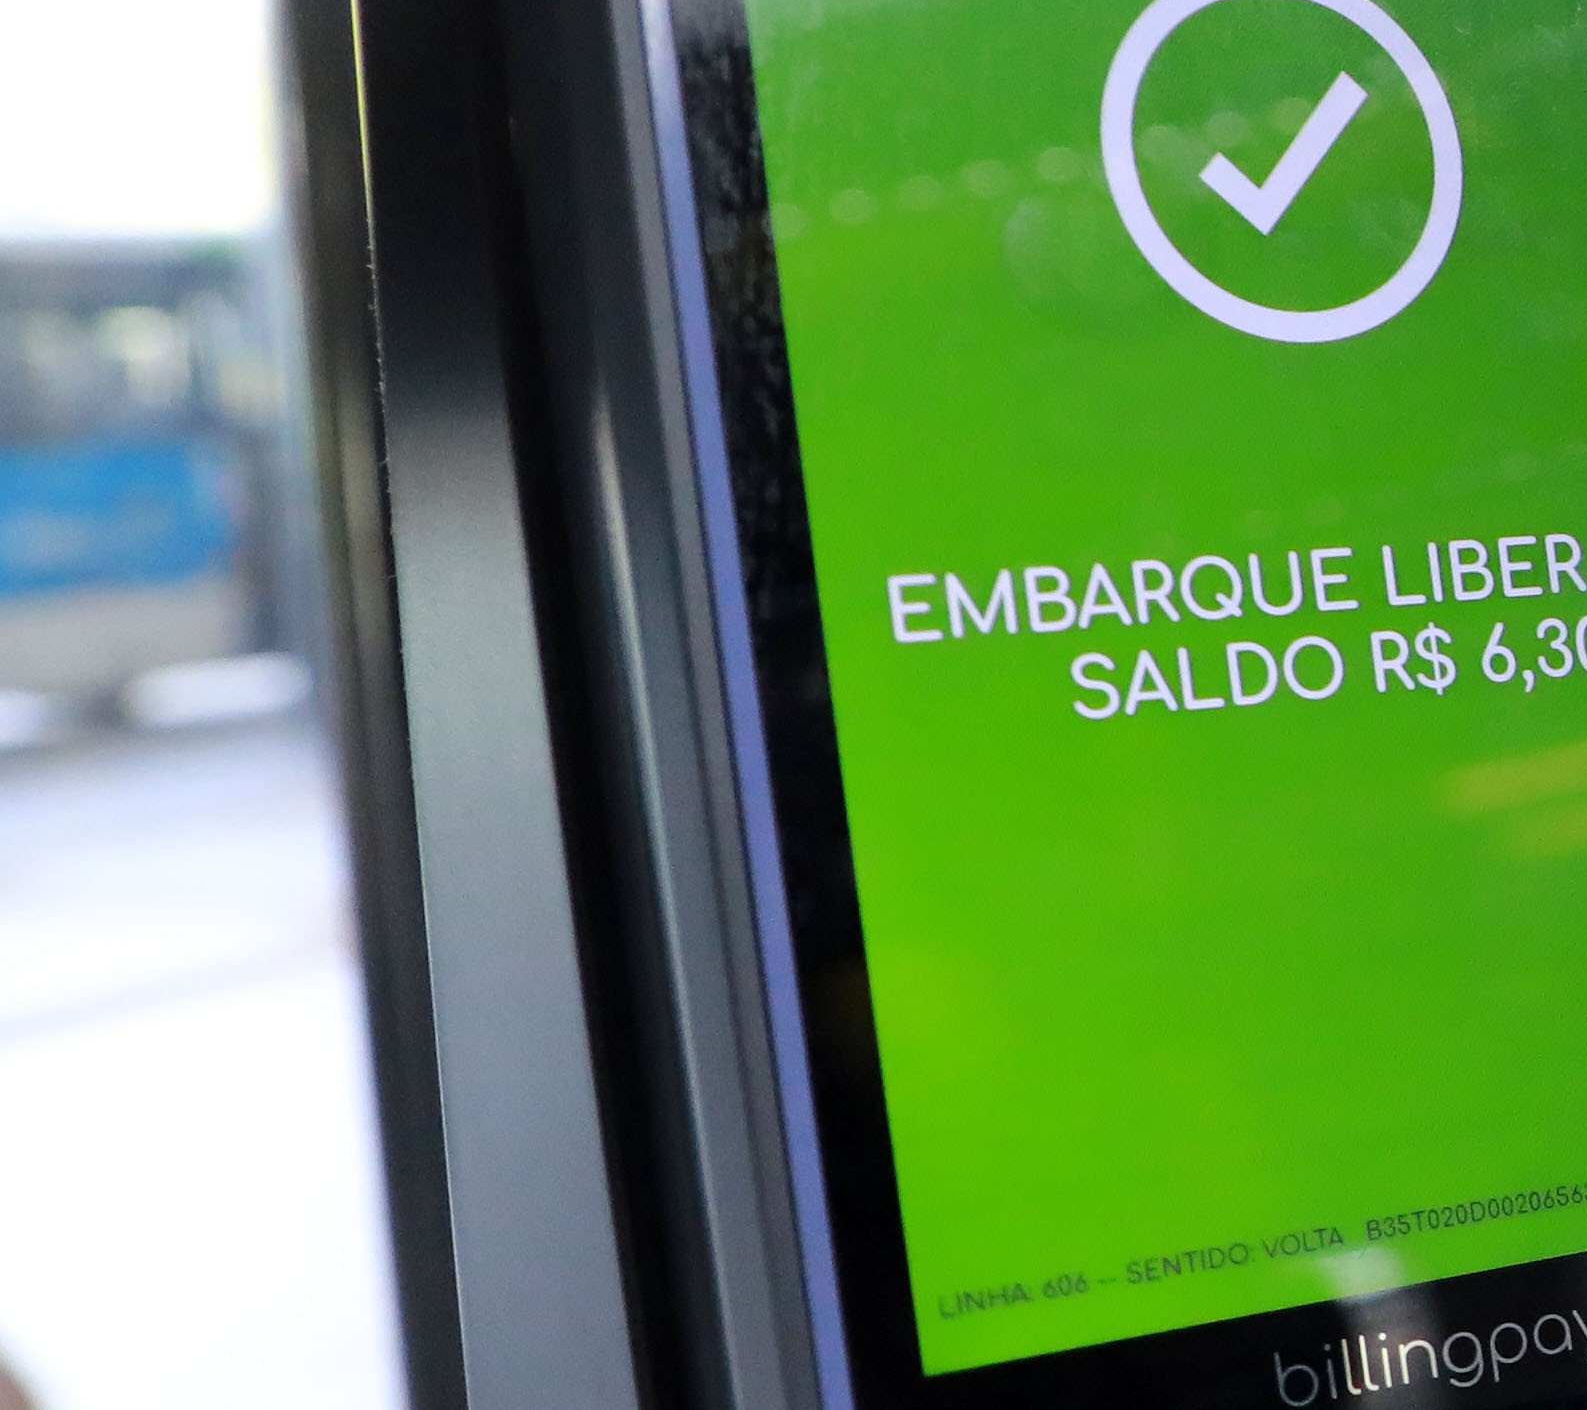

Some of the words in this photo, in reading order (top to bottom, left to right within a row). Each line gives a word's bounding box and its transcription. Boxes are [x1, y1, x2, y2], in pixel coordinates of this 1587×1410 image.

[885, 546, 1360, 644] EMBARQUE
[1069, 634, 1345, 721] SALDO
[1370, 622, 1458, 696] R$
[1042, 1273, 1090, 1299] 606
[1263, 1226, 1344, 1259] VOLTA
